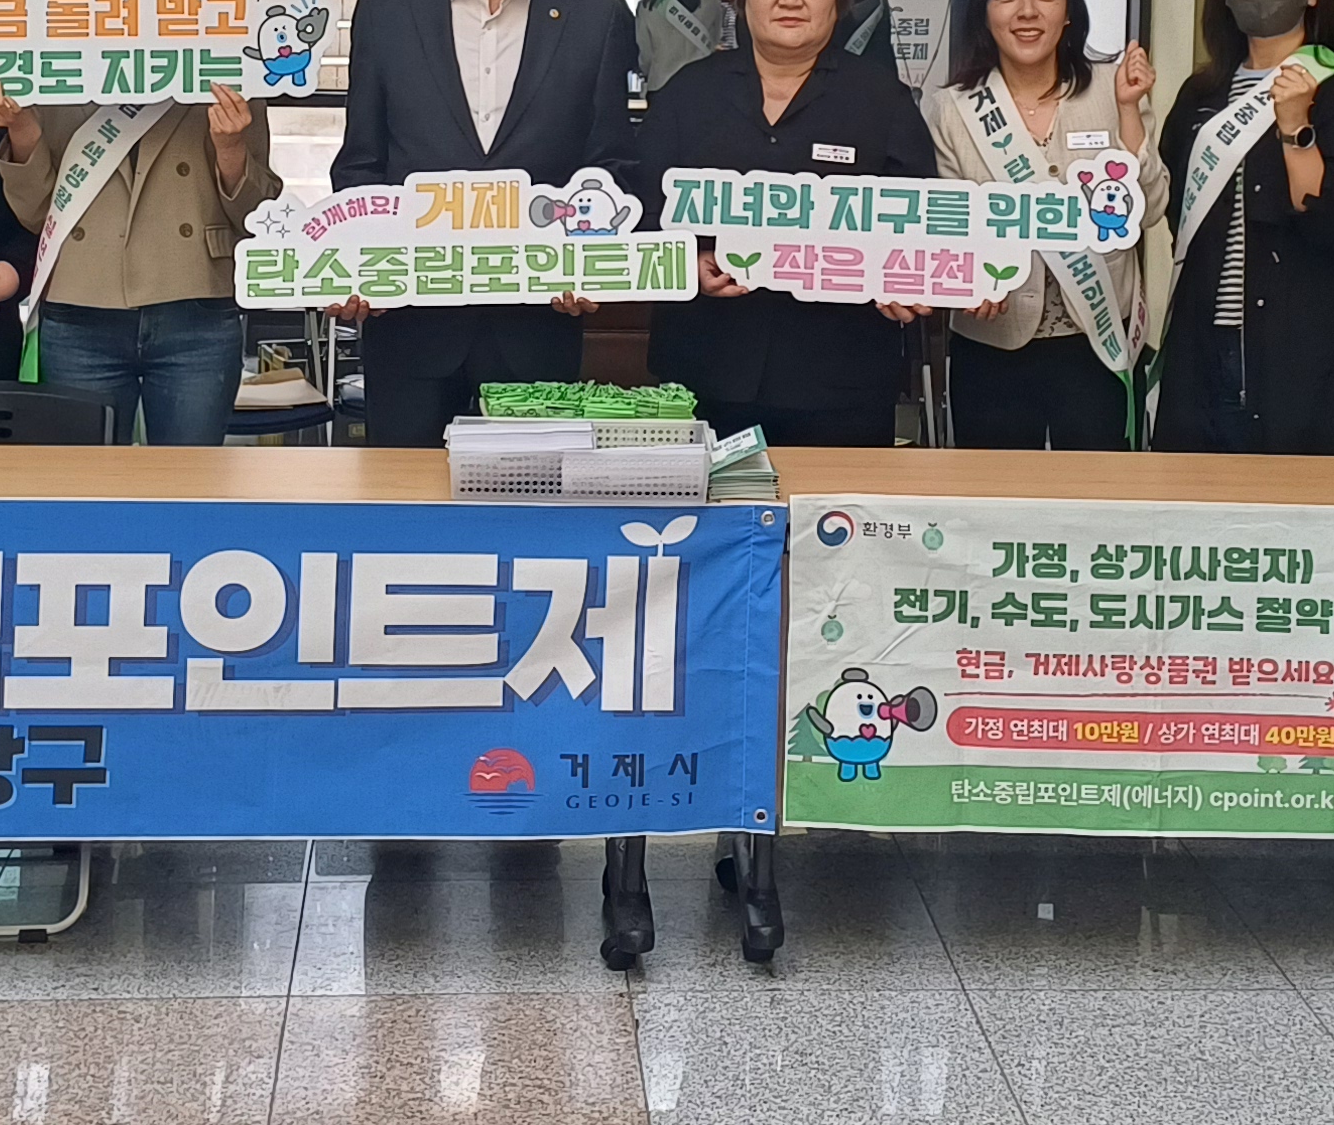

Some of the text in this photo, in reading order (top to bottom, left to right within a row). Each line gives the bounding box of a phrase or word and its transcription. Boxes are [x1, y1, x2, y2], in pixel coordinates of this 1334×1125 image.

[101, 48, 243, 94] 지키는
[968, 85, 1008, 137] 거제
[53, 118, 122, 212] 녹색생활
[302, 180, 520, 242] 함께해요! 거제
[670, 179, 1082, 242] 자녀와 지구를 위한
[246, 241, 686, 297] 탄소중립포인트제
[772, 243, 974, 297] 작은 실천
[862, 522, 913, 539] 환경부
[992, 542, 1314, 584] 가정, 상가(사업자)
[893, 587, 981, 628] 전기,
[991, 591, 1080, 632] 수도,
[1089, 593, 1244, 632] 도시가스
[956, 647, 1014, 680] 현금,
[1025, 652, 1217, 685] 거제사랑상품권
[965, 718, 1004, 740] 가정
[1009, 719, 1068, 742] 연최대
[1073, 722, 1139, 743] 10만원
[1157, 723, 1196, 745] 상가
[1201, 723, 1260, 746] 연최대
[559, 752, 699, 789] 거제시
[565, 791, 693, 810] GEOJE-SI
[951, 780, 1203, 811] 탄소중립포인트제(에너지)
